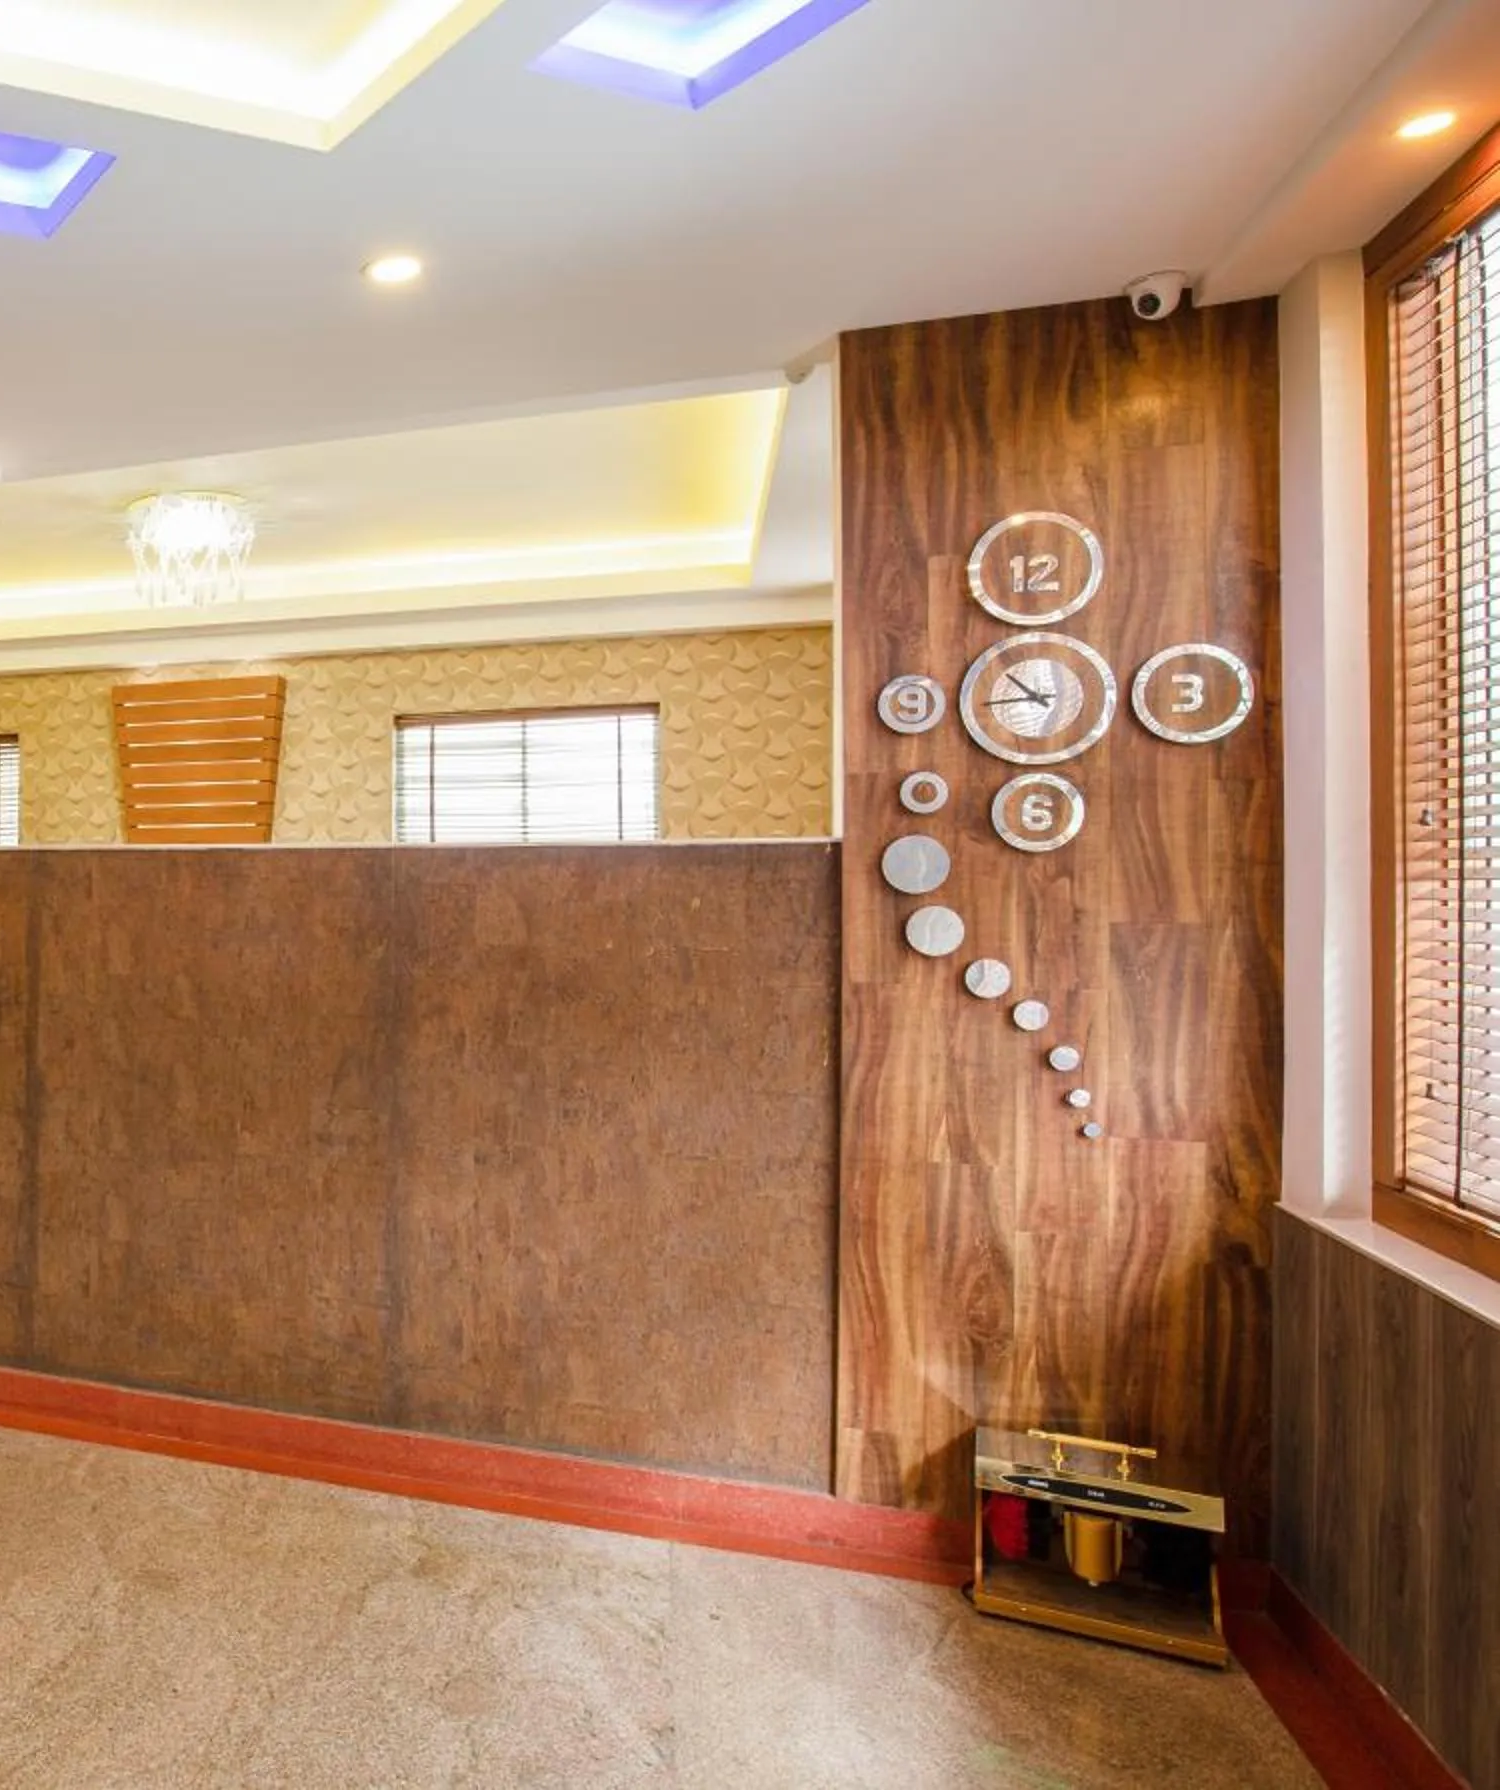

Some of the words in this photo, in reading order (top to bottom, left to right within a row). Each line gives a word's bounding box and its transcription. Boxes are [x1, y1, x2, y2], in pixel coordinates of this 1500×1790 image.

[1009, 554, 1060, 593] 12
[897, 686, 927, 722] 9
[1171, 674, 1204, 713] 3
[1021, 794, 1053, 831] 6
